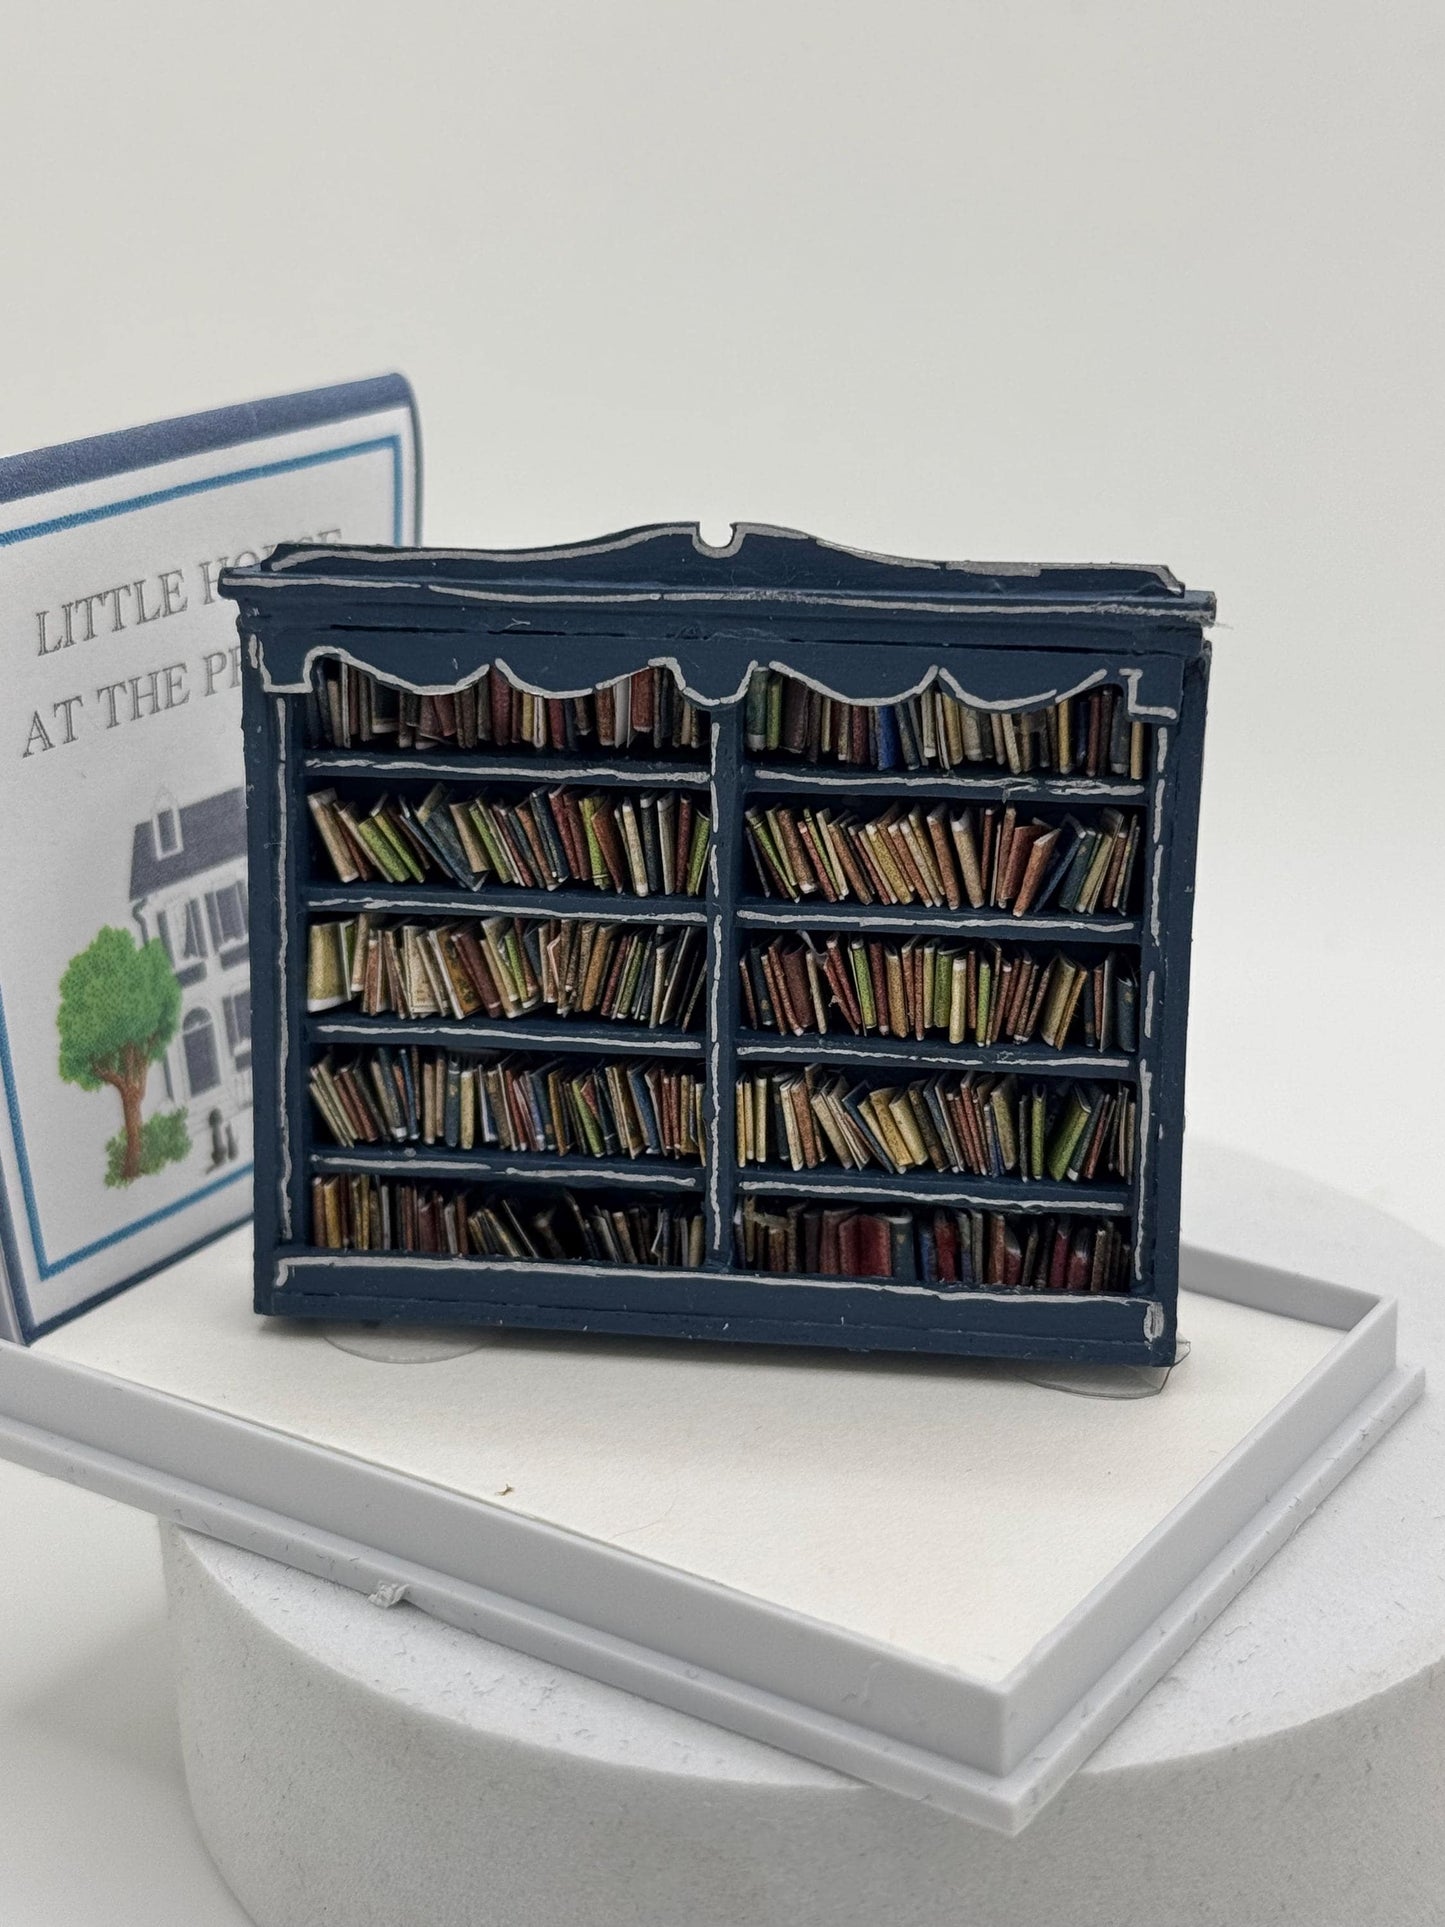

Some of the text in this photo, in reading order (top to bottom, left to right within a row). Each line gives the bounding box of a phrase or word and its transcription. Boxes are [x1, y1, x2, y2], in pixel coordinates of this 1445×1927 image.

[35, 569, 189, 656] LITTLE
[22, 695, 84, 758] AT
[96, 662, 191, 729] THE
